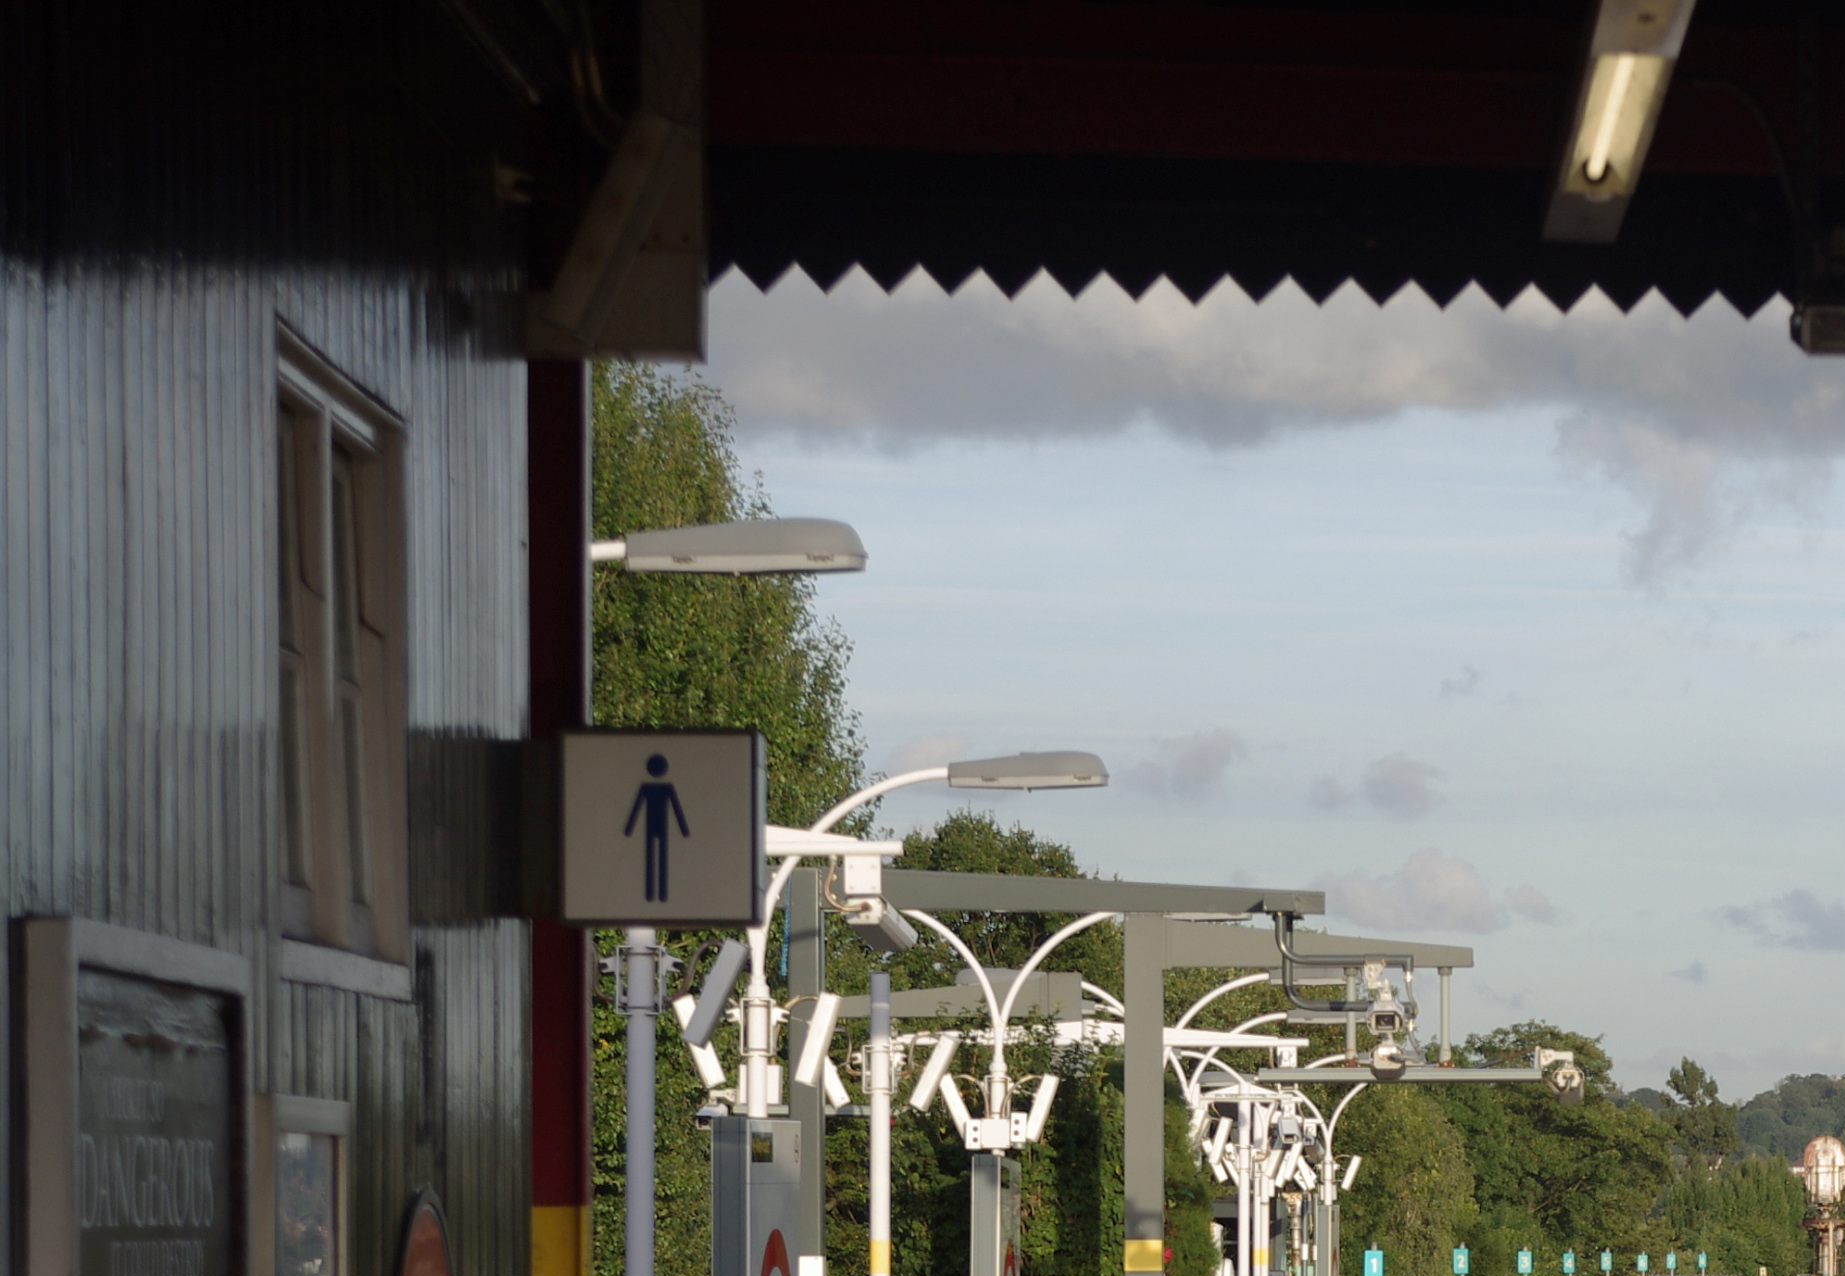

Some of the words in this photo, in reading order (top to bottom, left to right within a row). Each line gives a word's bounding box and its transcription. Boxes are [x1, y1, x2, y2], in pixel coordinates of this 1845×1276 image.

[80, 1133, 214, 1228] DANGEROUS
[1370, 1257, 1377, 1273] 1
[1456, 1254, 1465, 1268] 2
[1520, 1256, 1529, 1269] 3
[1565, 1257, 1573, 1269] 4
